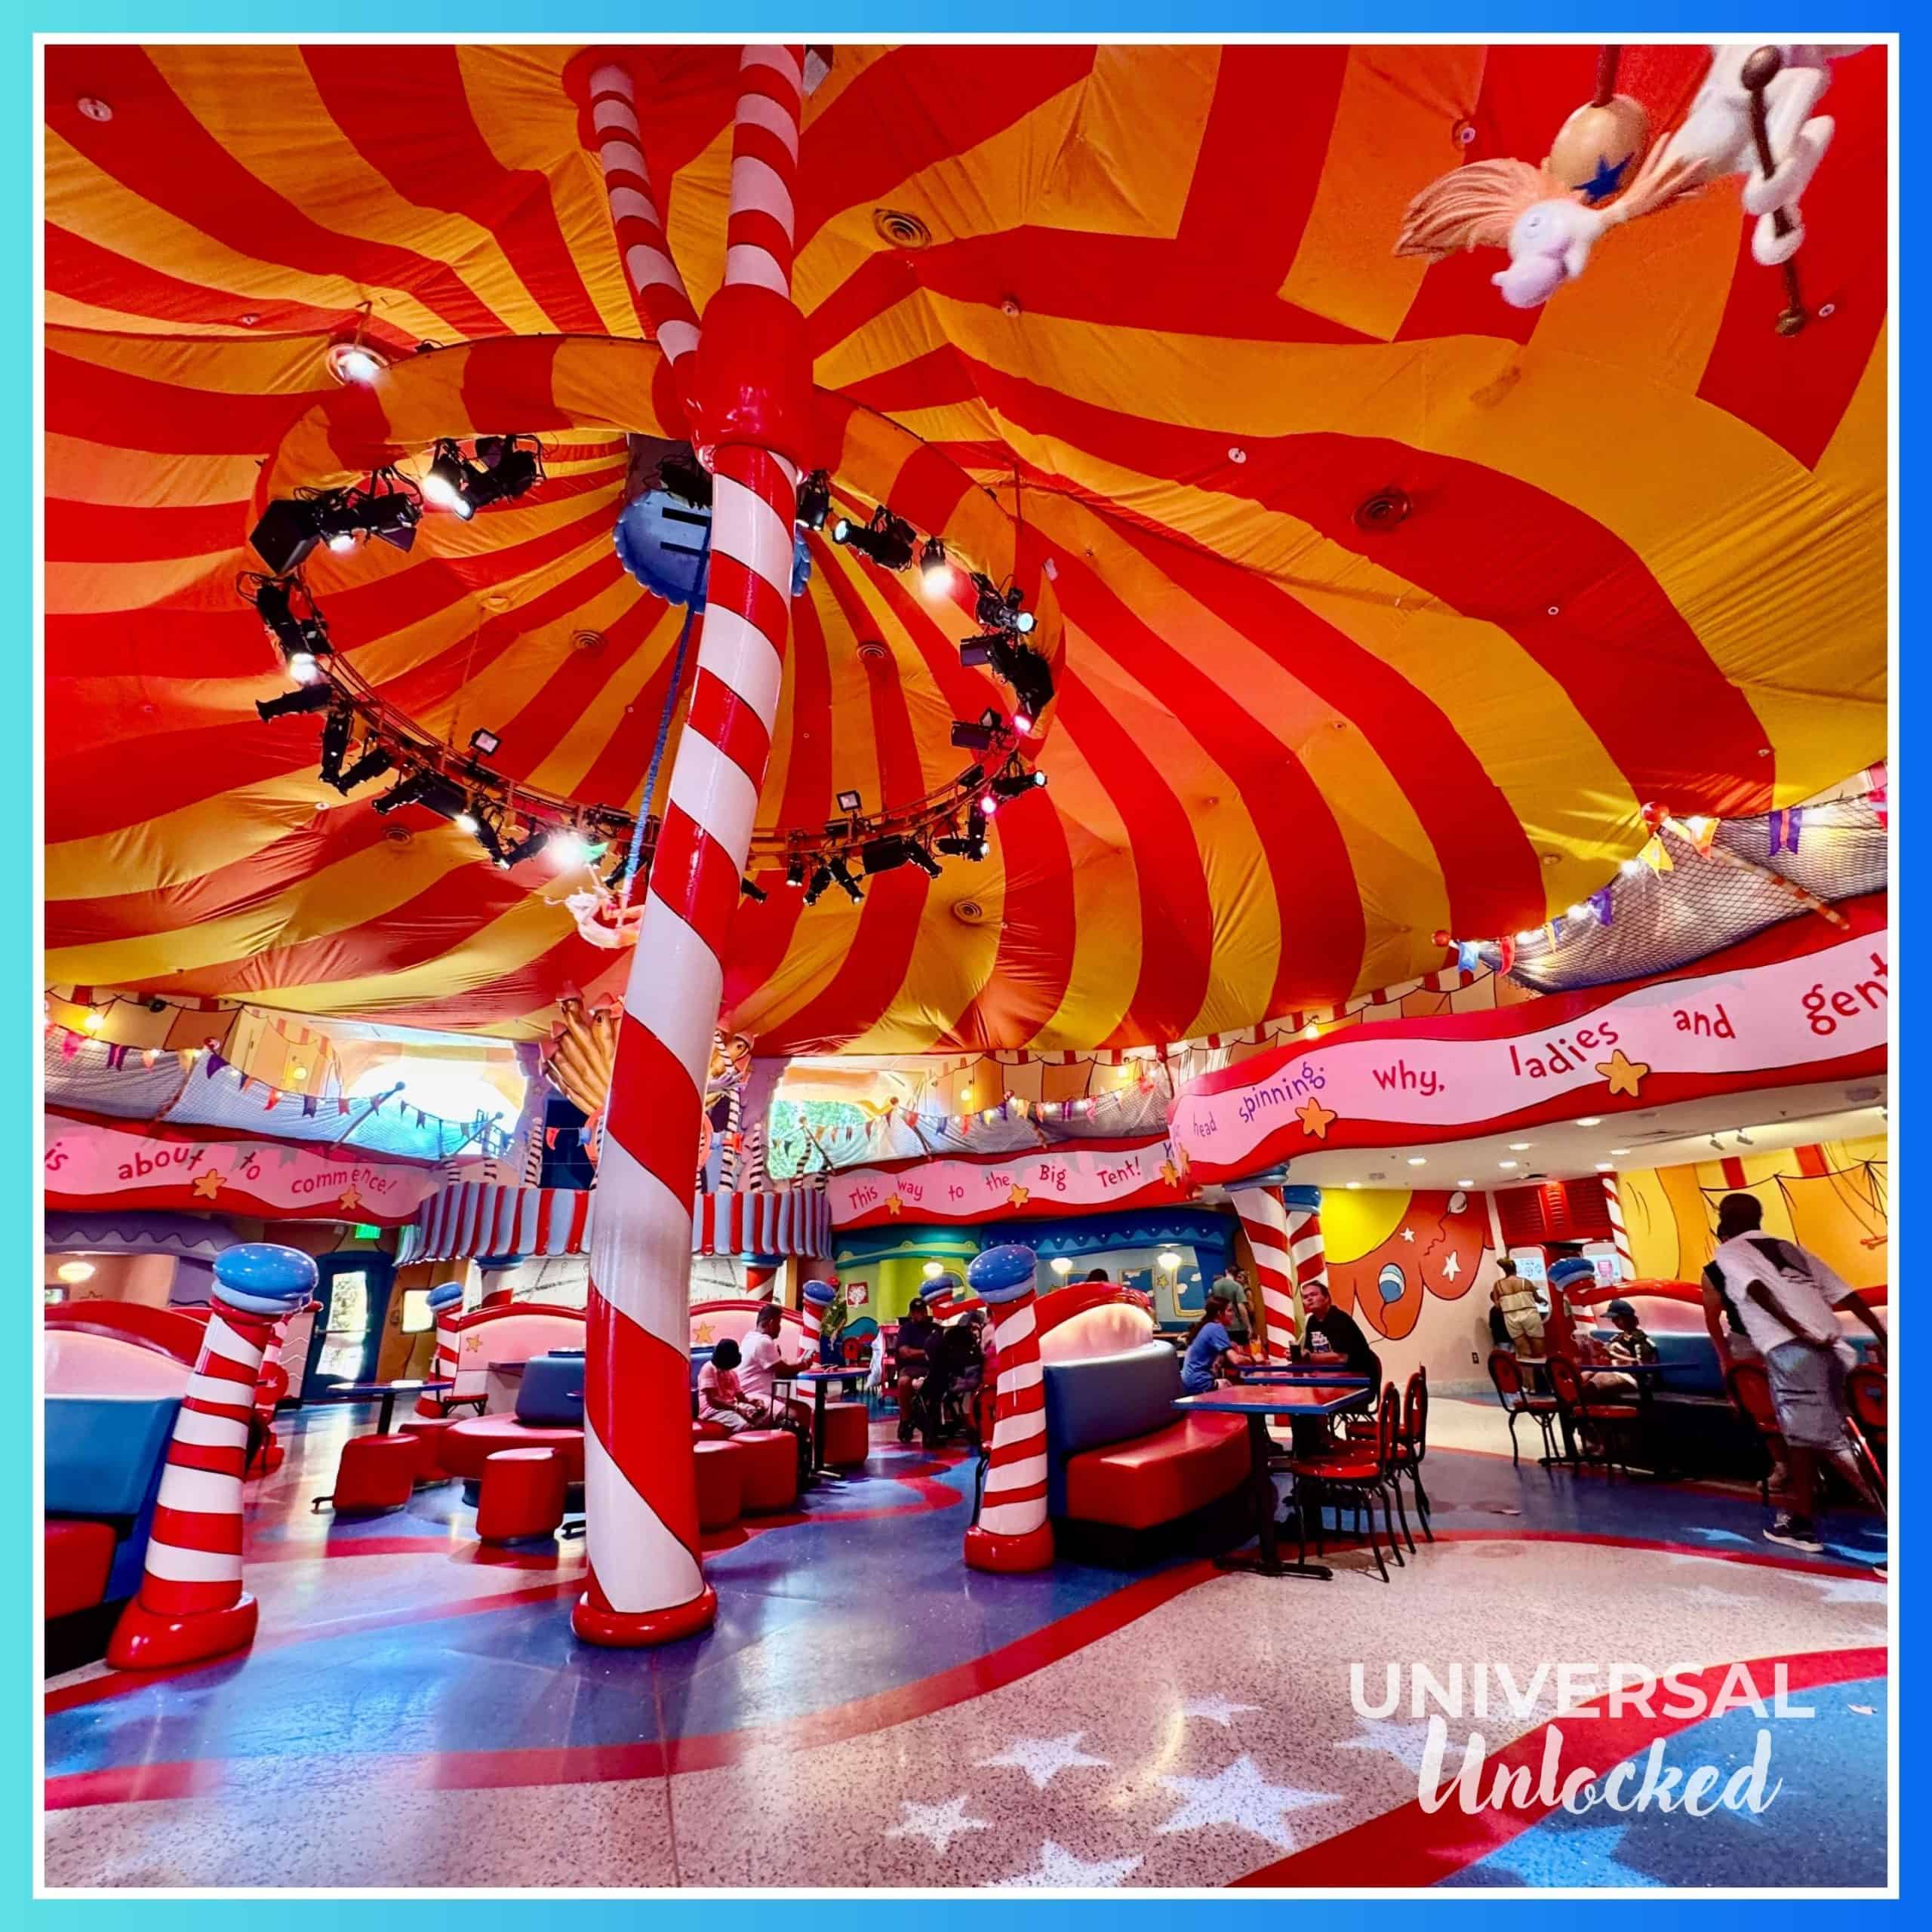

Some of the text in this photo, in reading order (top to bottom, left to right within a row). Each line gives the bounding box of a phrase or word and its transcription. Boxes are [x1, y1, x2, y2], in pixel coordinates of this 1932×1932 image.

[1192, 1110, 1217, 1137] head
[1509, 1021, 1619, 1078] ladies
[1672, 1004, 1737, 1039] and
[45, 1142, 397, 1195] is about to commence!
[849, 1156, 1141, 1209] This way to the Big Tent!
